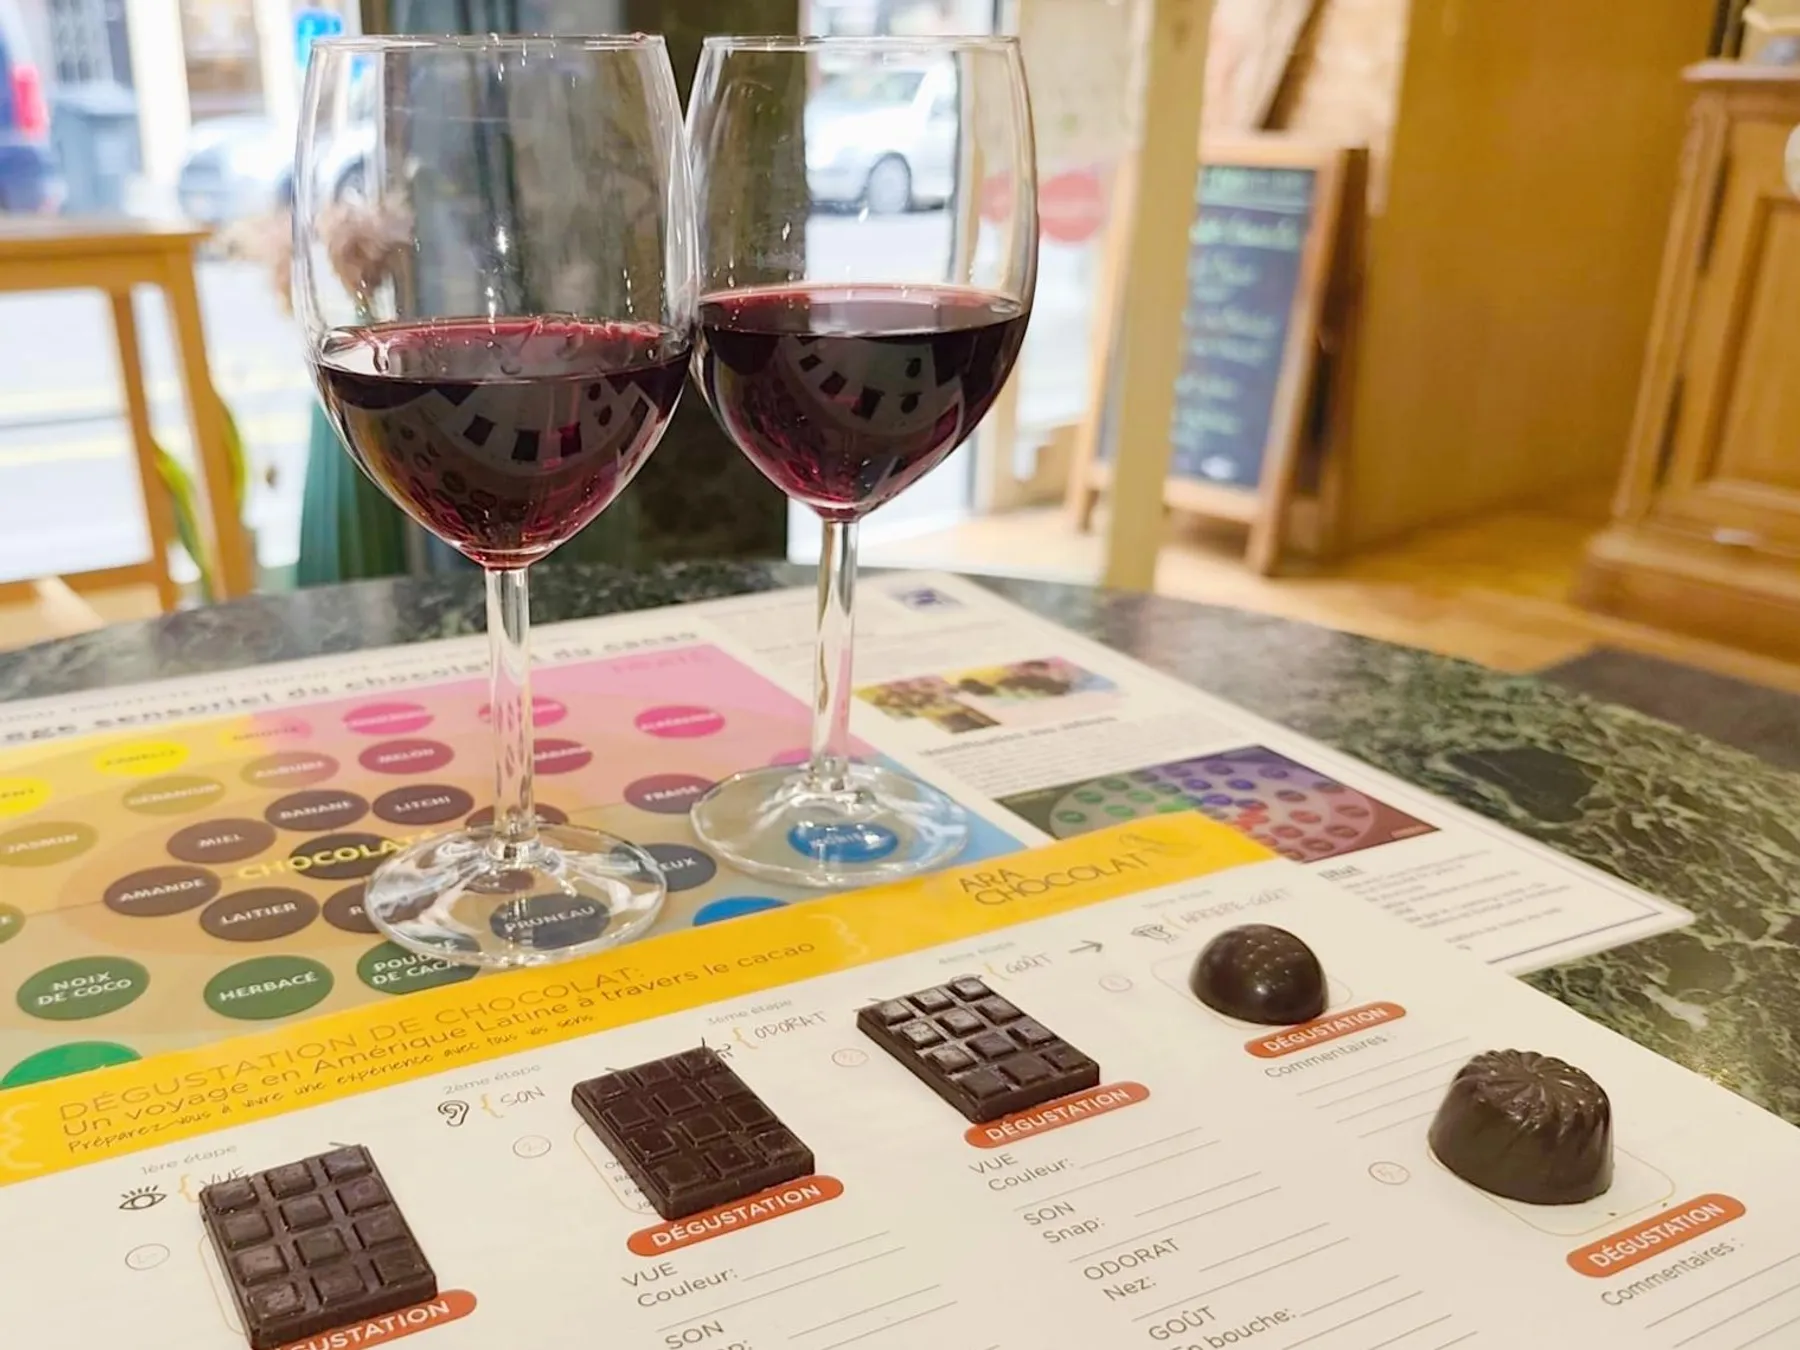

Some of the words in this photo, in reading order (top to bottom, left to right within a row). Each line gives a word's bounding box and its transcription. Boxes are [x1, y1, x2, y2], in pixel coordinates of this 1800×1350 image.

[198, 834, 242, 849] MIEL
[118, 879, 207, 902] AMANDE
[958, 867, 1023, 893] ARA
[973, 852, 1149, 906] CHOCOLAT
[219, 902, 298, 925] LAITIER
[504, 905, 596, 933] PRUNEAU
[37, 992, 68, 1006] DE
[73, 978, 133, 998] COCO
[52, 971, 112, 991] NOIX
[218, 970, 319, 1001] HERBACÉ
[371, 970, 402, 985] DE
[62, 1116, 113, 1138] Un
[124, 1082, 249, 1121] voyage
[261, 1068, 301, 1087] en
[314, 1026, 467, 1075] Amérique
[475, 1002, 569, 1033] Latine
[578, 995, 595, 1009] à
[600, 968, 699, 1002] travers
[702, 962, 730, 976] le
[736, 942, 816, 968] cacao
[754, 1010, 827, 1040] ODORAT
[1262, 1007, 1391, 1054] DÉGUSTATION
[59, 1033, 359, 1122] DÉGUSTATION
[369, 1017, 426, 1042] DE
[246, 1090, 285, 1108] vivre
[294, 1081, 325, 1097] une
[337, 1052, 434, 1086] expérience
[443, 1042, 480, 1058] avec
[500, 1086, 546, 1107] SON
[984, 1088, 1131, 1142] DÉGUSTATION
[967, 1152, 1019, 1176] VUE
[987, 1157, 1076, 1192] Couleur:
[650, 1183, 823, 1248] DÉGUSTATION
[1022, 1200, 1076, 1227] SON
[1042, 1216, 1106, 1245] Snap:
[1587, 1201, 1727, 1268] DÉGUSTATION
[621, 1261, 679, 1288] VUE
[1083, 1237, 1183, 1283] ODORAT
[637, 1267, 739, 1308] Couleur:
[1102, 1273, 1158, 1302] Nez:
[663, 1320, 725, 1350] SON
[1202, 1308, 1297, 1349] bouche:
